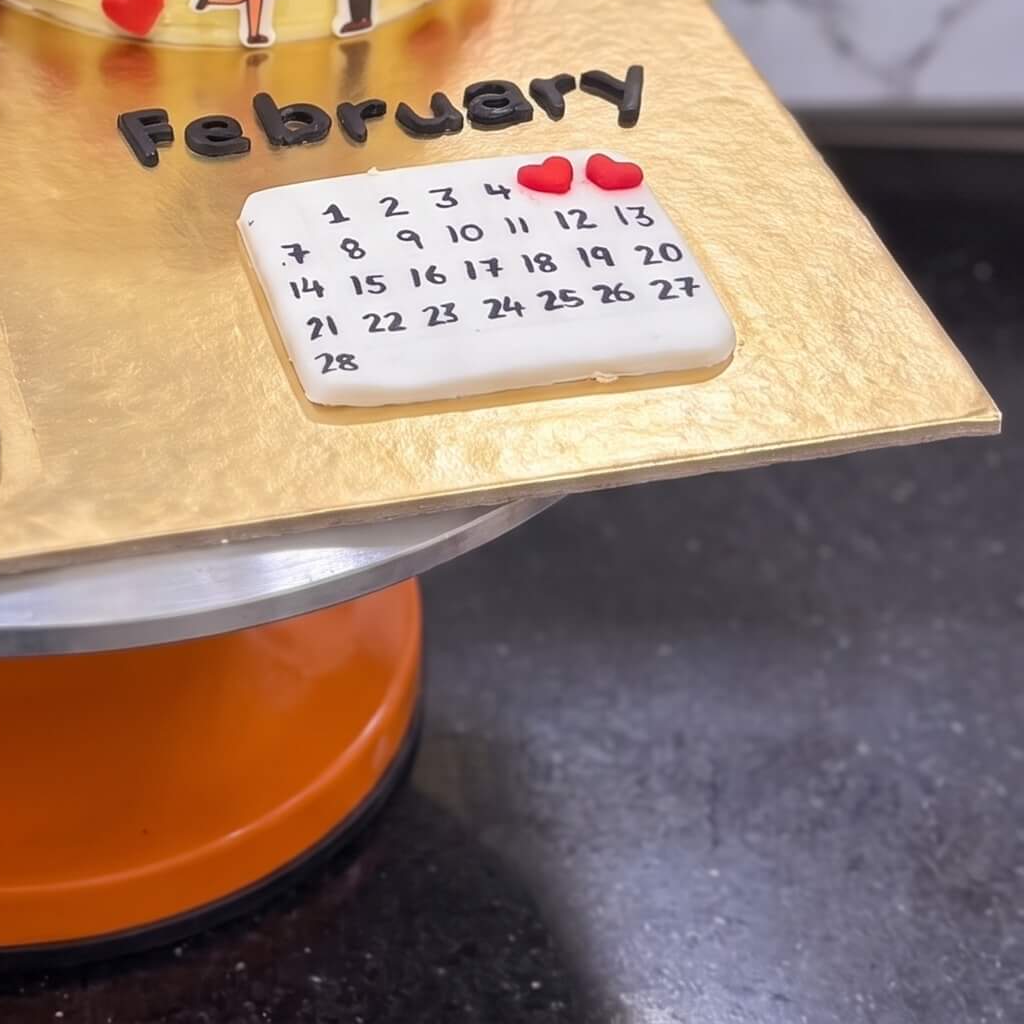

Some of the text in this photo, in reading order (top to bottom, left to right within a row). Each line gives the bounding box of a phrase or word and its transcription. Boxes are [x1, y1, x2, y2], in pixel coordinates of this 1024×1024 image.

[116, 65, 645, 168] February
[322, 183, 511, 224] 1 2 3 4
[280, 205, 655, 265] 7 8 9 10 11 12 13
[289, 242, 683, 299] 14 15 16 17 18 19 20
[306, 276, 701, 341] 21 22 23 24 25 26 27
[314, 352, 359, 375] 28
